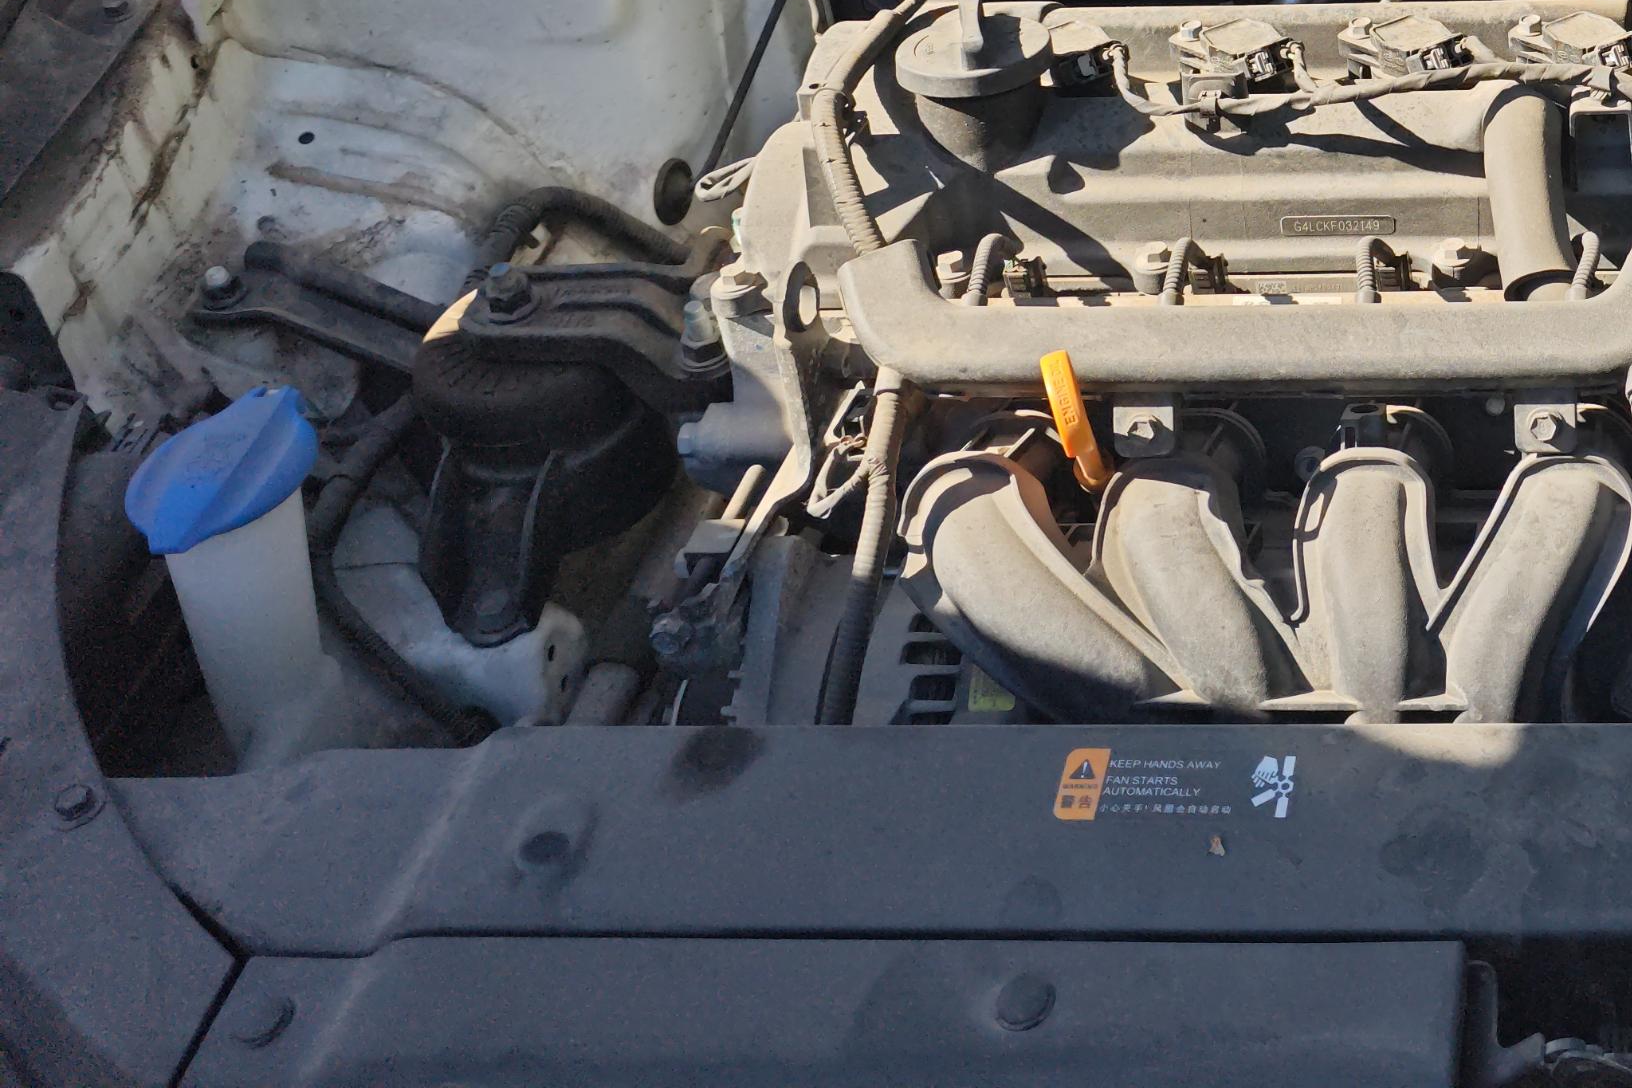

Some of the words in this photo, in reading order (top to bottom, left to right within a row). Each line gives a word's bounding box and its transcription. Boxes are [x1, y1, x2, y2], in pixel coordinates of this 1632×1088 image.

[1294, 220, 1380, 232] G4LCKF032149
[1109, 759, 1141, 769] KEEP
[1143, 760, 1184, 769] HANDS
[1187, 760, 1222, 769] AWAY
[1105, 776, 1130, 785] FAN
[1131, 776, 1178, 785] STARTS
[1103, 787, 1201, 797] AUTOMATICALLY
